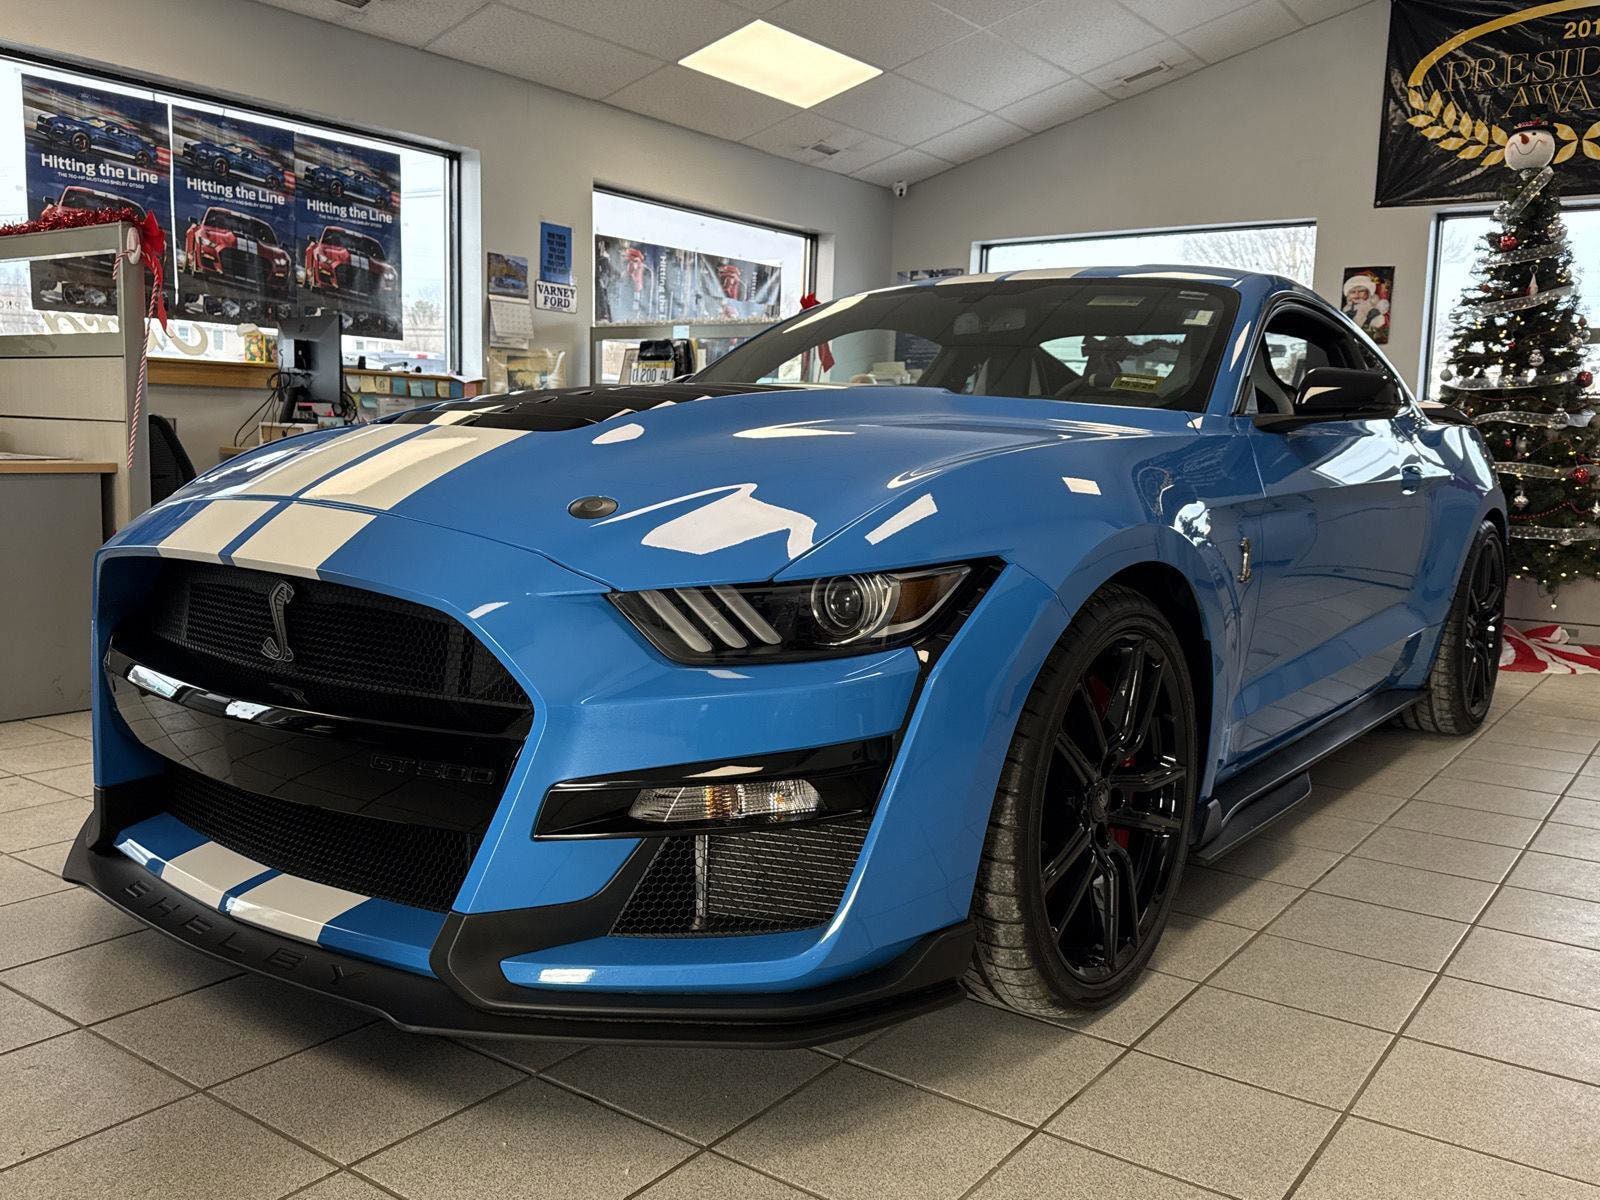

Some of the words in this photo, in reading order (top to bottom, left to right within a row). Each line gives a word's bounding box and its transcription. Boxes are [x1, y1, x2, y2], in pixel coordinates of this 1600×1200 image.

[41, 153, 96, 176] Hitting
[99, 162, 124, 178] the
[128, 167, 158, 184] Line
[186, 177, 233, 198] Hitting
[235, 186, 256, 200] the
[259, 190, 285, 205] Line
[307, 198, 347, 218] Hitting
[349, 206, 367, 220] the
[369, 209, 393, 224] Line
[538, 284, 576, 299] VARNEY
[543, 295, 570, 308] FORD
[122, 880, 366, 984] SHELBY
